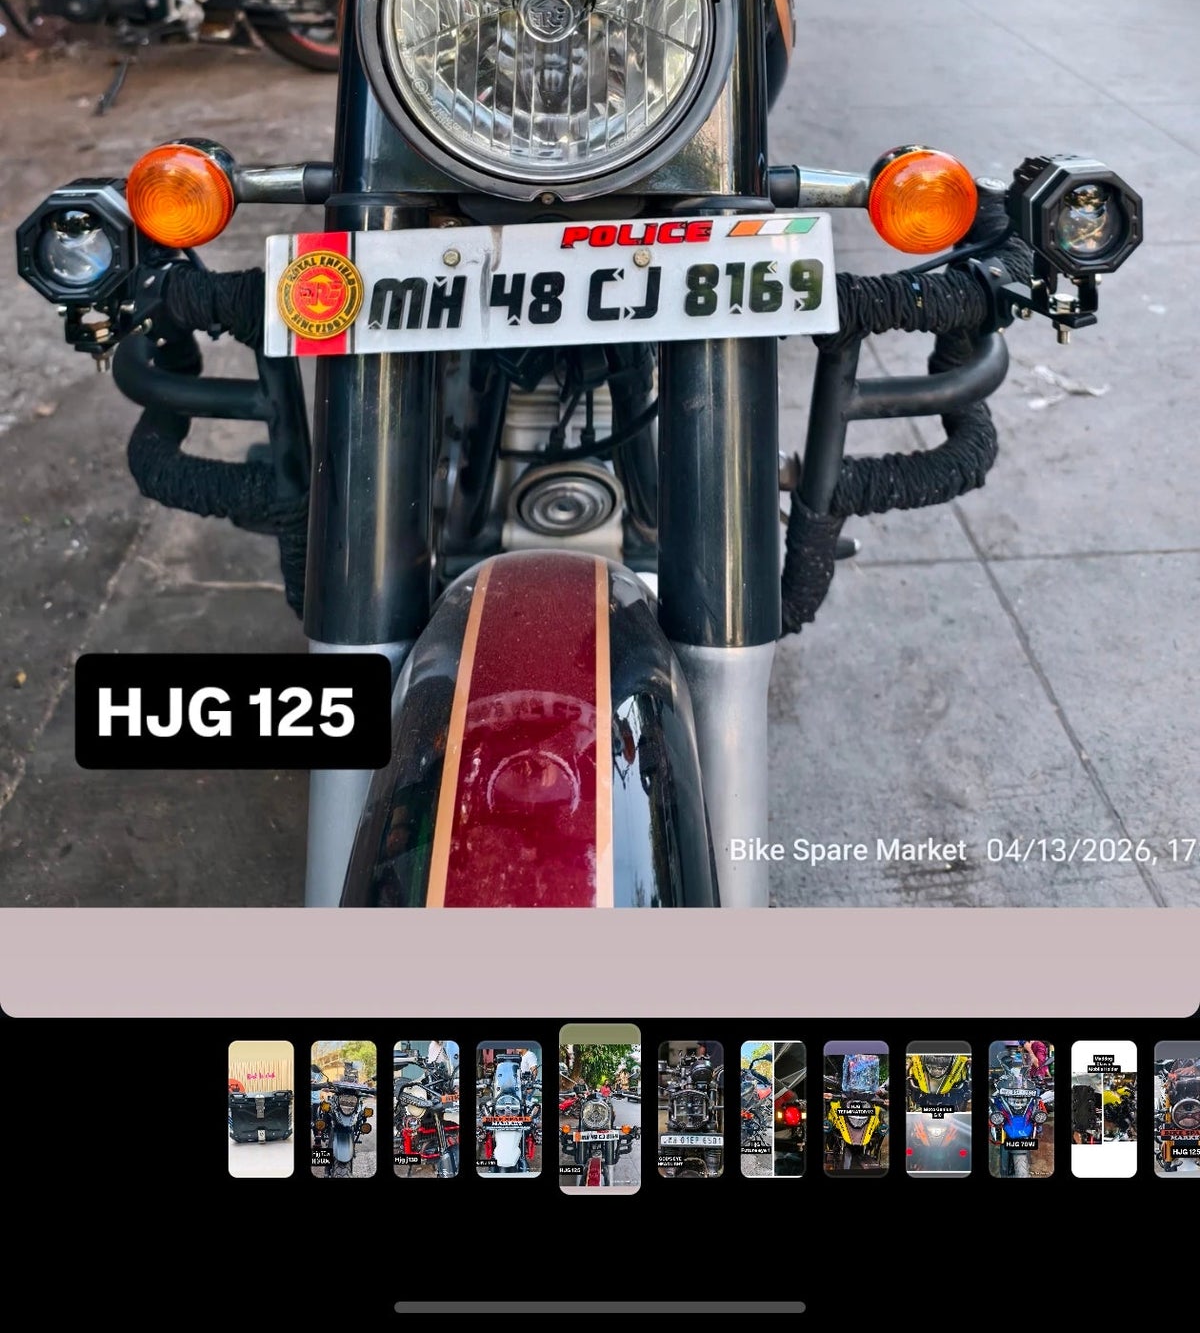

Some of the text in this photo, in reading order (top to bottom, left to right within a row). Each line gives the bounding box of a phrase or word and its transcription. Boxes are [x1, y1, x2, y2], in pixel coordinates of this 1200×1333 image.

[561, 220, 713, 249] POLICE
[320, 256, 355, 286] ENFIELD
[368, 258, 824, 330] MH 48 CJ 8169
